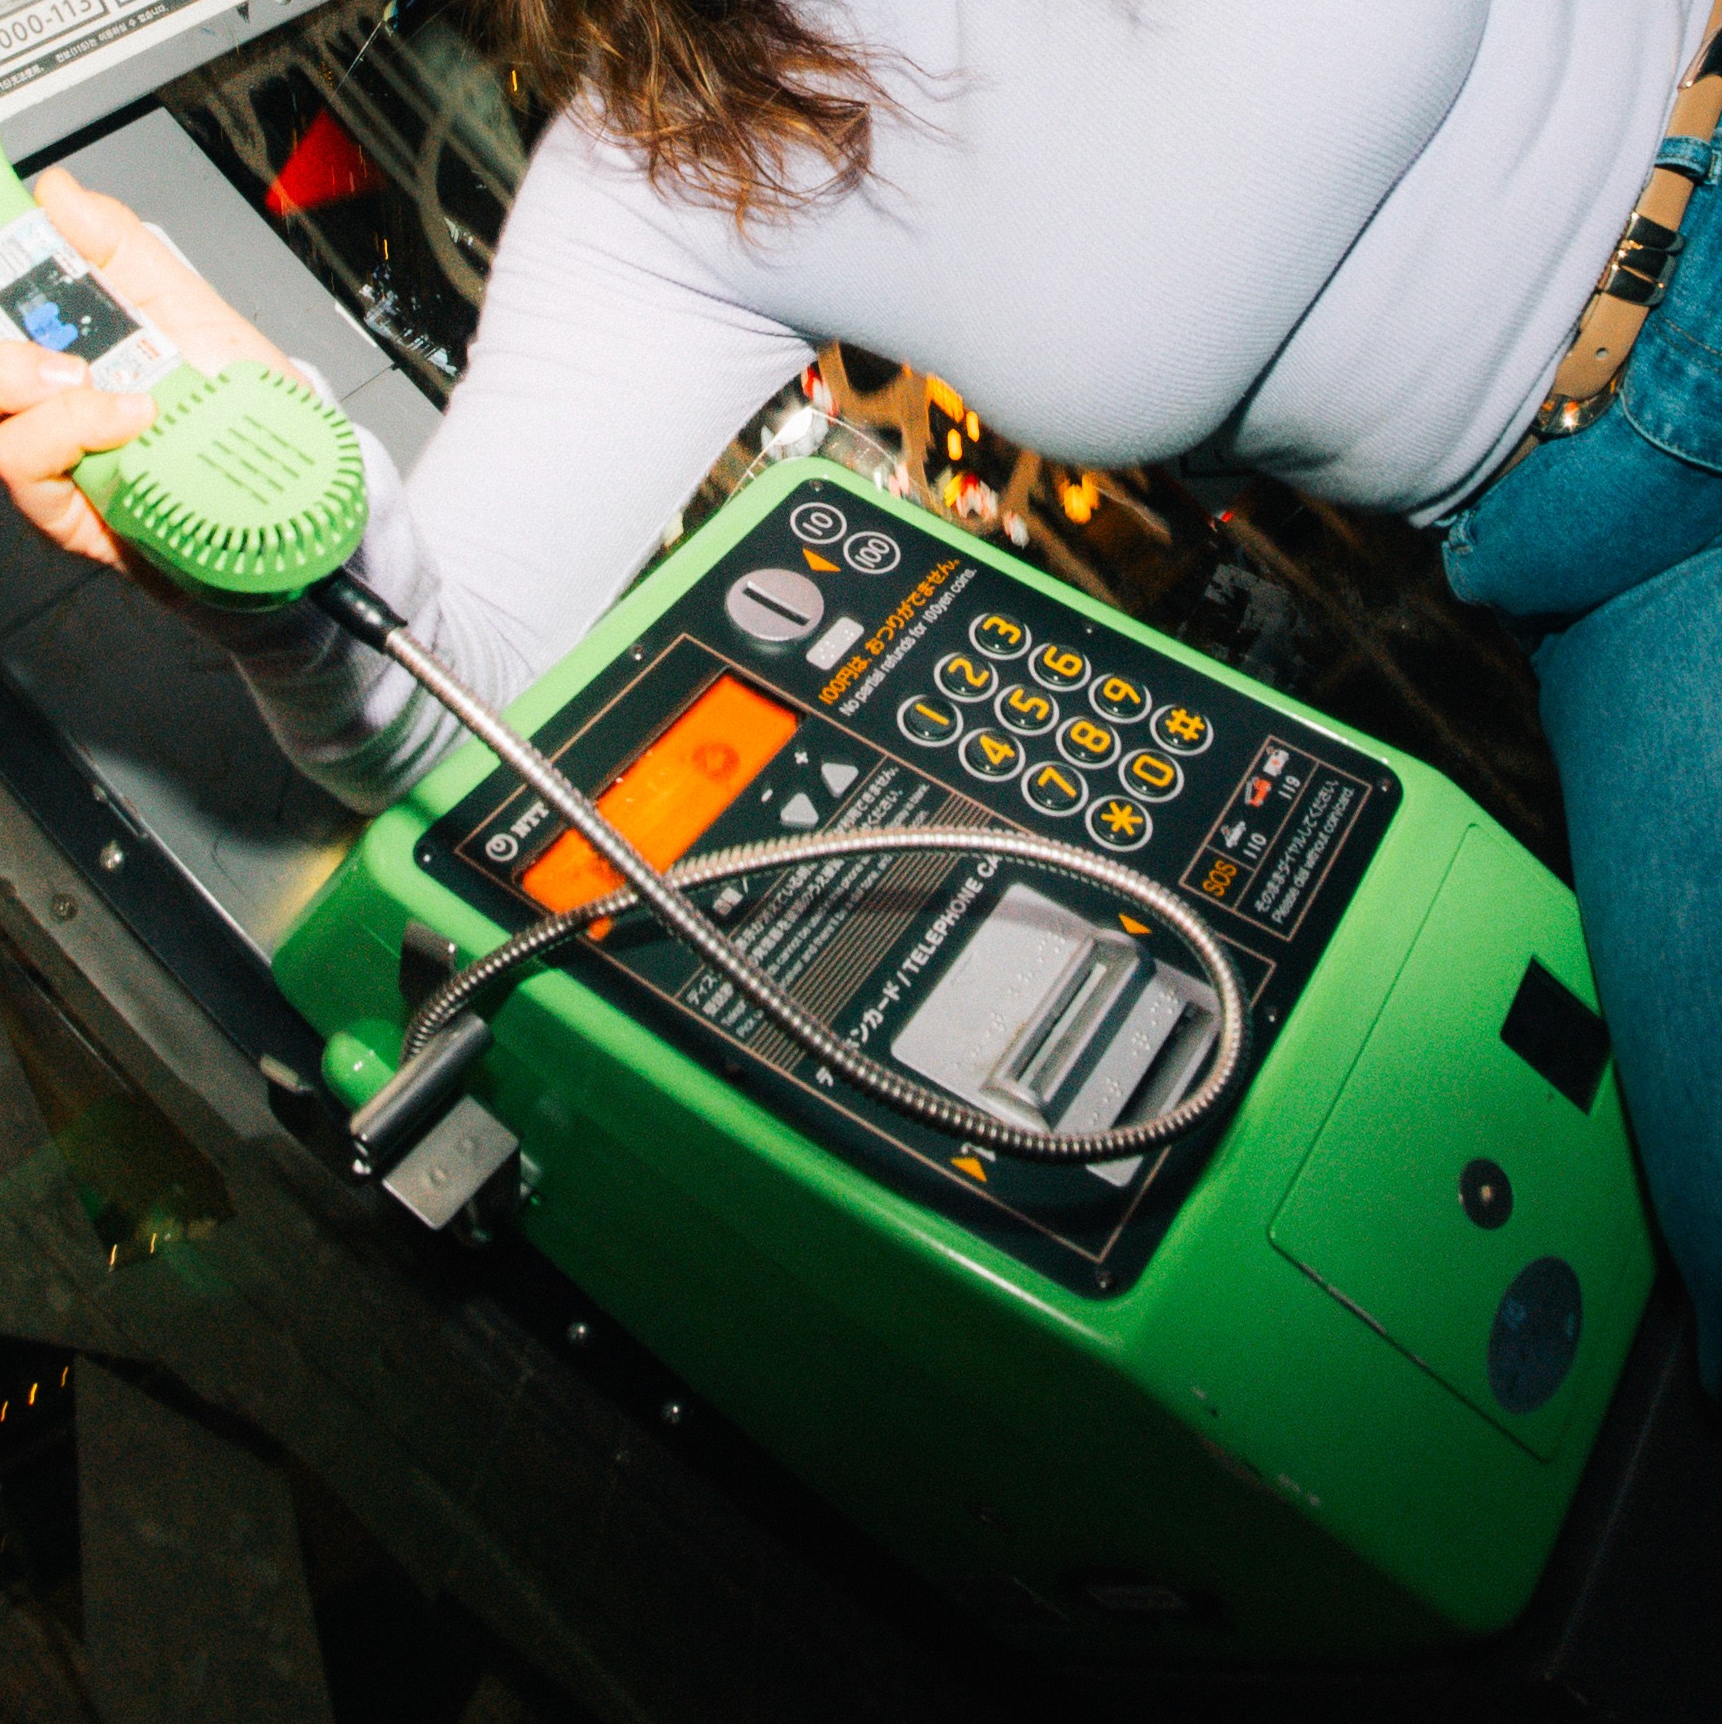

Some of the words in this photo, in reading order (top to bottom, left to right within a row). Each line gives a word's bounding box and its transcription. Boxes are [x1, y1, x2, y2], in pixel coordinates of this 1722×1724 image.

[802, 511, 833, 536] 10
[854, 538, 889, 568] 100
[814, 553, 961, 706] 100円は、おつりがでません。
[838, 699, 859, 716] No
[854, 668, 885, 702] partial
[880, 635, 916, 672] refunds
[908, 621, 927, 638] for
[921, 591, 955, 623] 100yen
[949, 568, 976, 593] coins.
[915, 703, 949, 725] 1
[947, 657, 989, 687] 2
[982, 615, 1021, 644] 3
[979, 734, 1015, 765] 4
[1008, 688, 1049, 719] 5
[1043, 645, 1087, 676] 6
[1037, 764, 1084, 797] 7
[1070, 720, 1110, 752] 8
[1102, 677, 1147, 703] 9
[1132, 754, 1179, 786] 0
[1165, 708, 1210, 740] #
[510, 800, 549, 837] NTT
[1277, 774, 1300, 799] 119
[1202, 859, 1237, 896] SOS
[1242, 832, 1267, 859] 110
[1271, 886, 1300, 923] Please
[1293, 866, 1310, 887] dial
[1303, 831, 1329, 868] without
[901, 876, 983, 972] TELEPHONE
